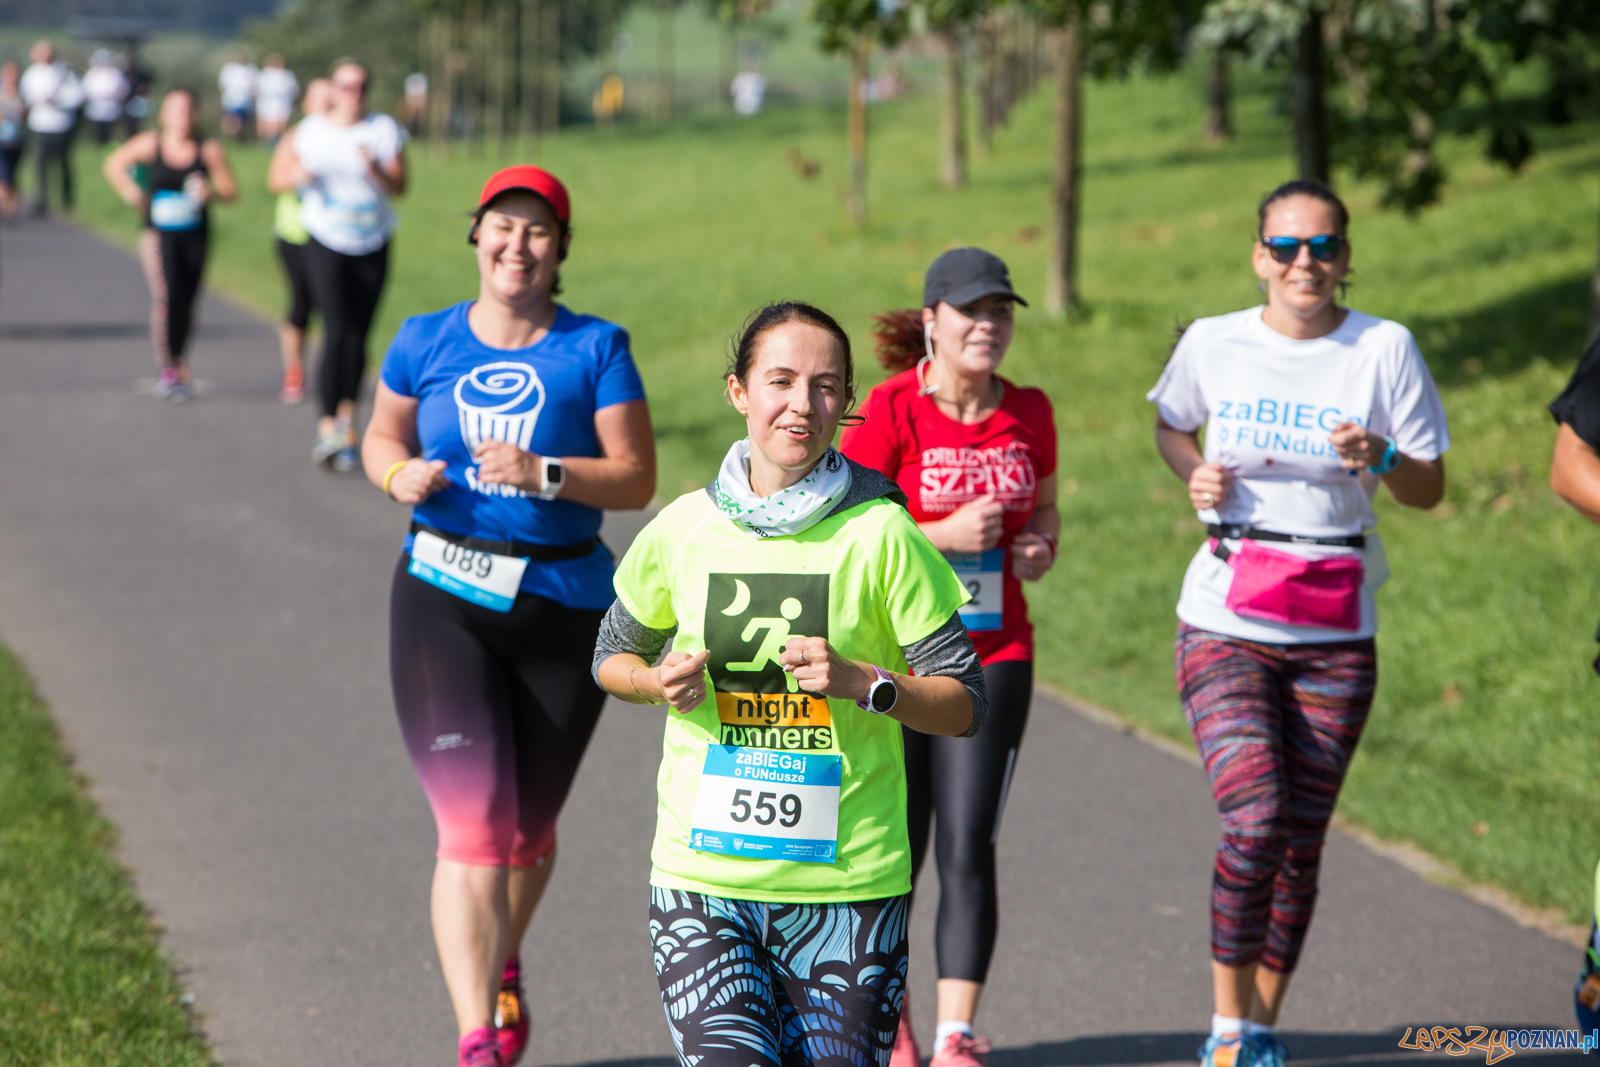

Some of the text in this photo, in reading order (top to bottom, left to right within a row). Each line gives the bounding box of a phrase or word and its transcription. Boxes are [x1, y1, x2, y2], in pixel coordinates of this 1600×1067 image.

[919, 463, 1036, 498] SZPIKU
[443, 541, 493, 579] 089
[737, 694, 811, 725] night
[720, 724, 833, 749] runners
[734, 766, 805, 783] o FUNdusze
[735, 751, 807, 773] zaBIEGaj
[730, 788, 802, 828] 559
